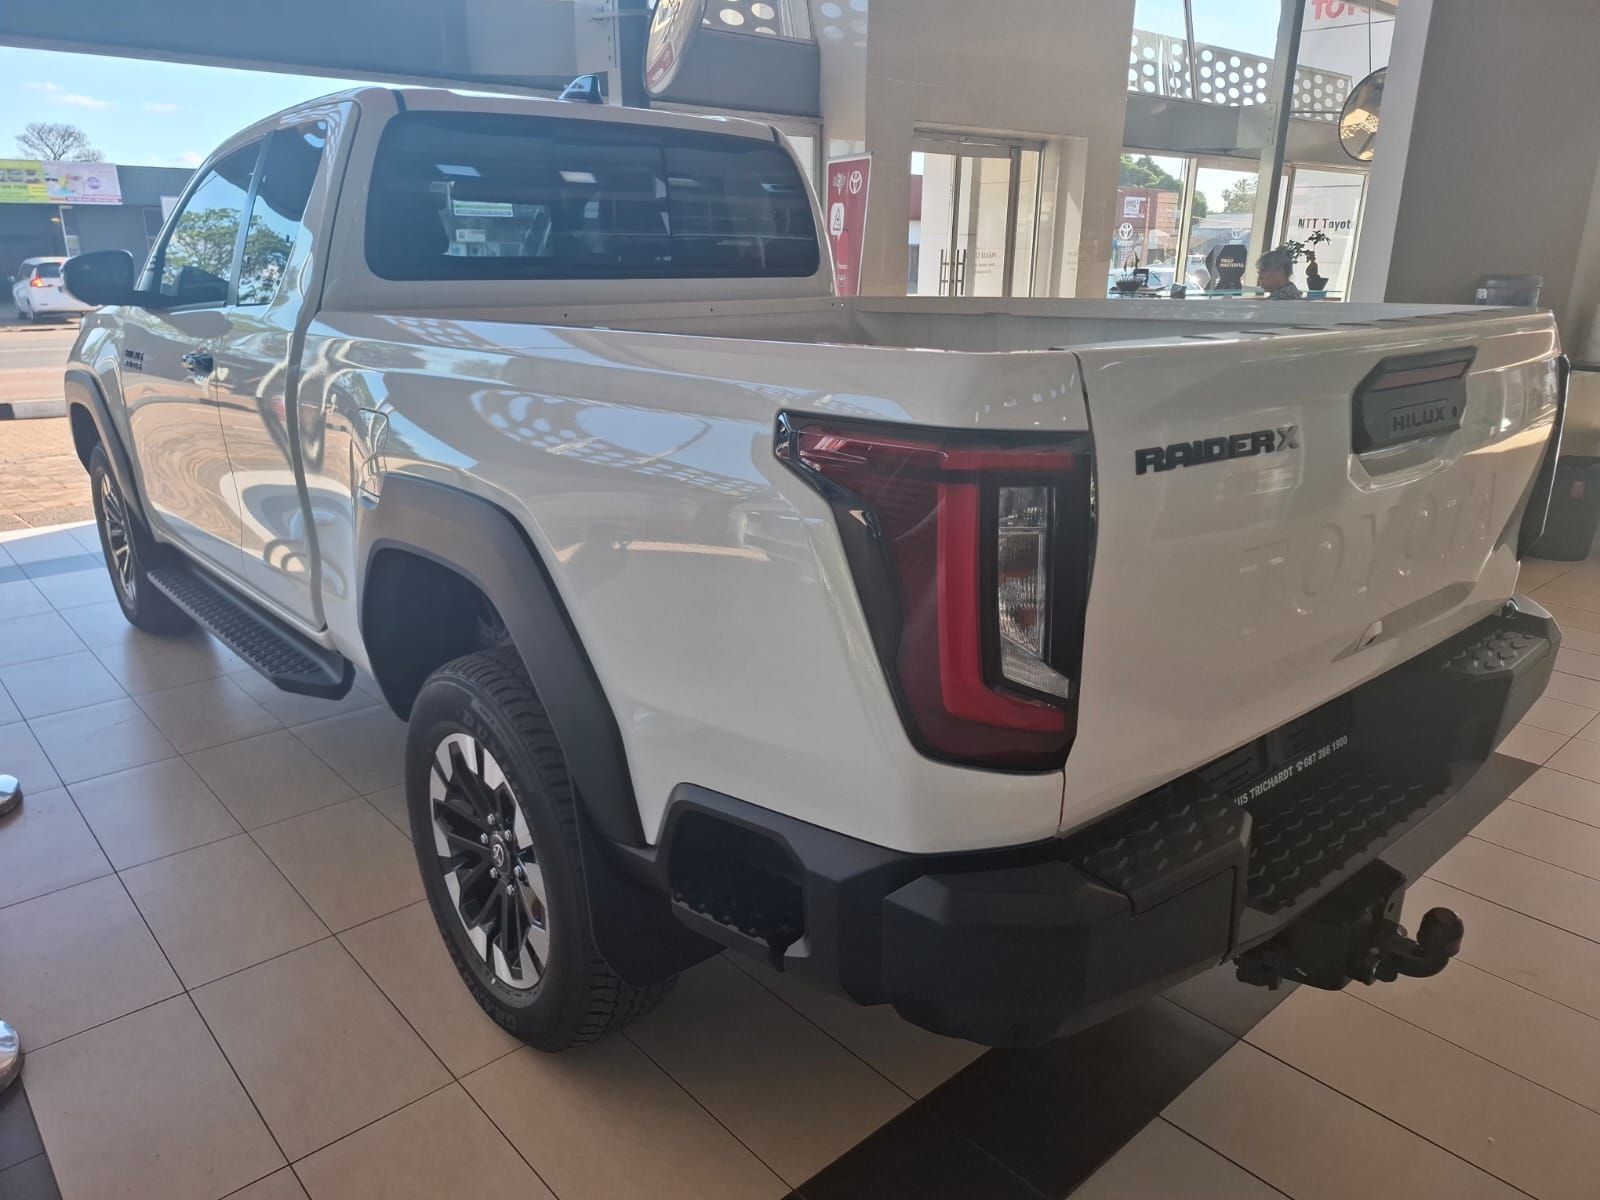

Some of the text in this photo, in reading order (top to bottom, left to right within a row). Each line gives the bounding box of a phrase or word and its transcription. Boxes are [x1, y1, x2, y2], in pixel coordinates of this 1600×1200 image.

[1297, 217, 1352, 232] NTT Toyot
[1392, 406, 1445, 431] HILUX
[1249, 766, 1293, 800] TRICHARDT
[1303, 752, 1317, 768] 087
[1331, 735, 1348, 752] 1900
